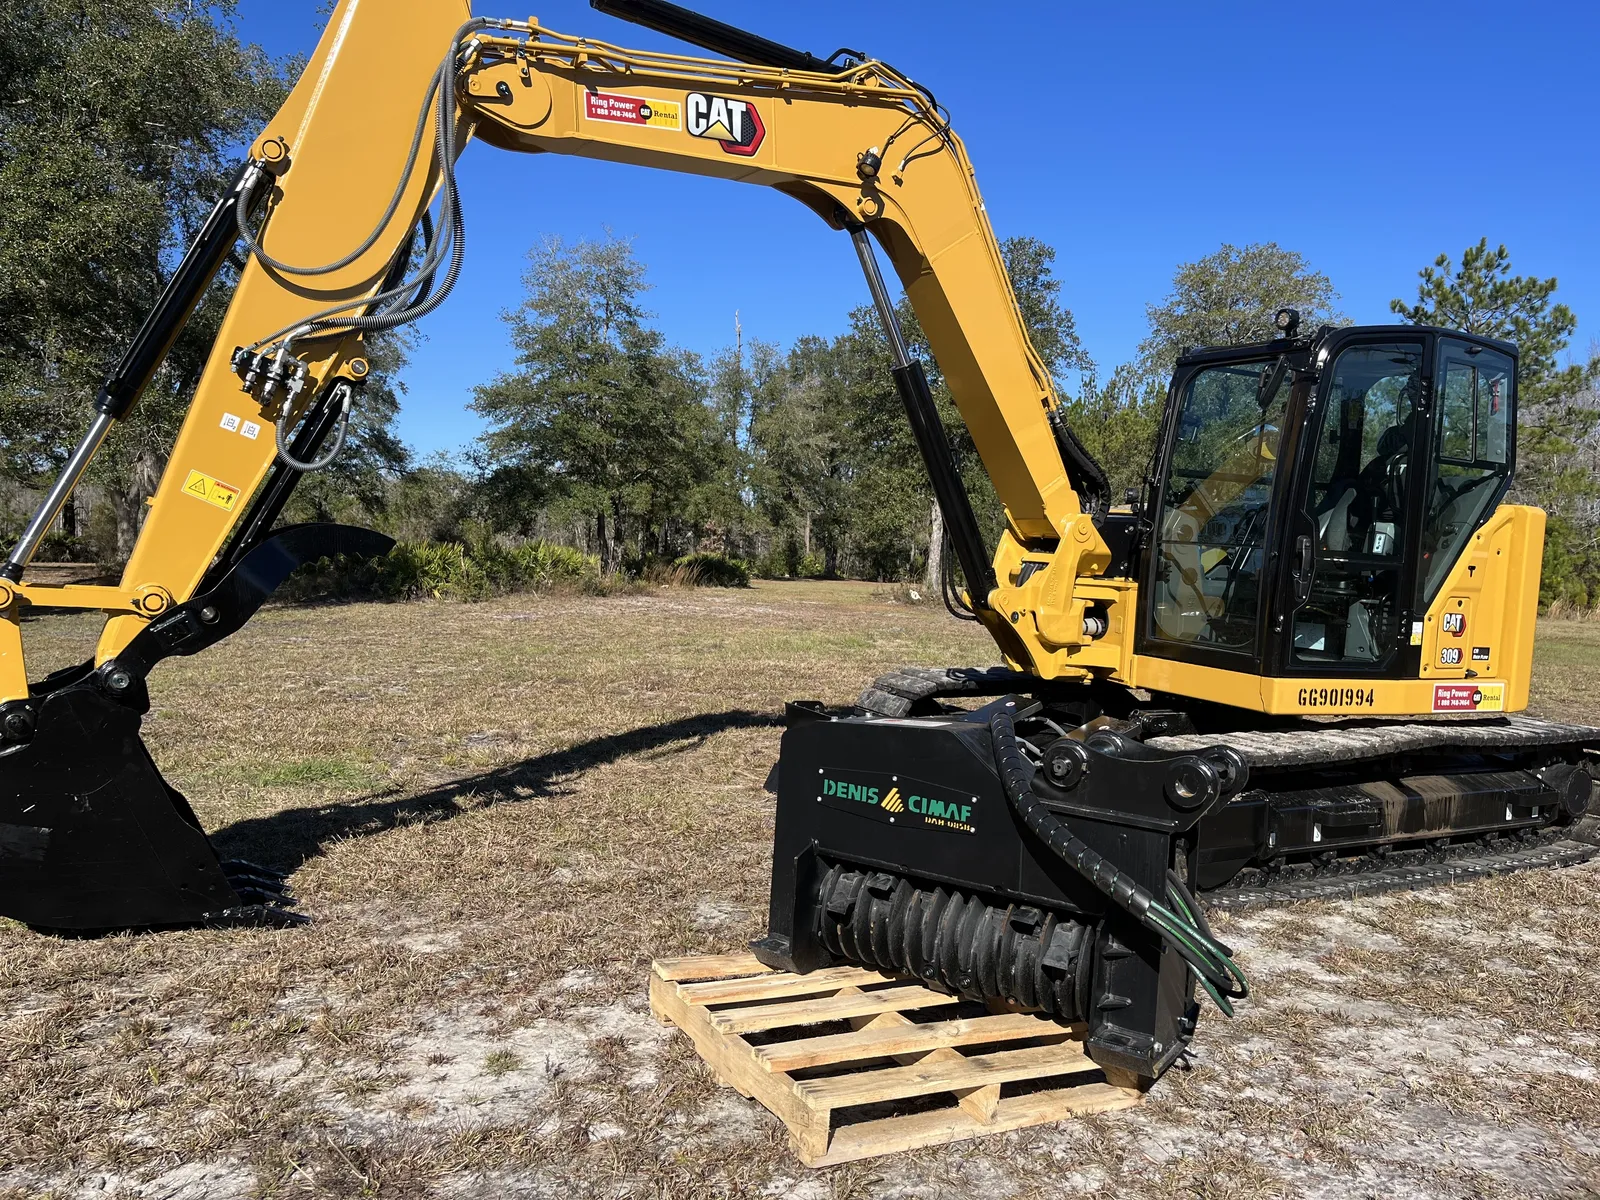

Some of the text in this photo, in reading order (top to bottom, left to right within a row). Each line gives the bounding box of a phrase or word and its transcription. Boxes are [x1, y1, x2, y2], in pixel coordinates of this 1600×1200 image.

[590, 96, 633, 110] Ring Power
[597, 108, 608, 116] 888
[640, 108, 678, 120] CAT Rental
[687, 92, 746, 143] CAT
[1443, 613, 1462, 632] CAT
[1441, 648, 1459, 663] 309
[1438, 689, 1470, 699] Ring Power
[1473, 694, 1482, 702] CAT
[823, 779, 972, 822] DENIS CIMAF
